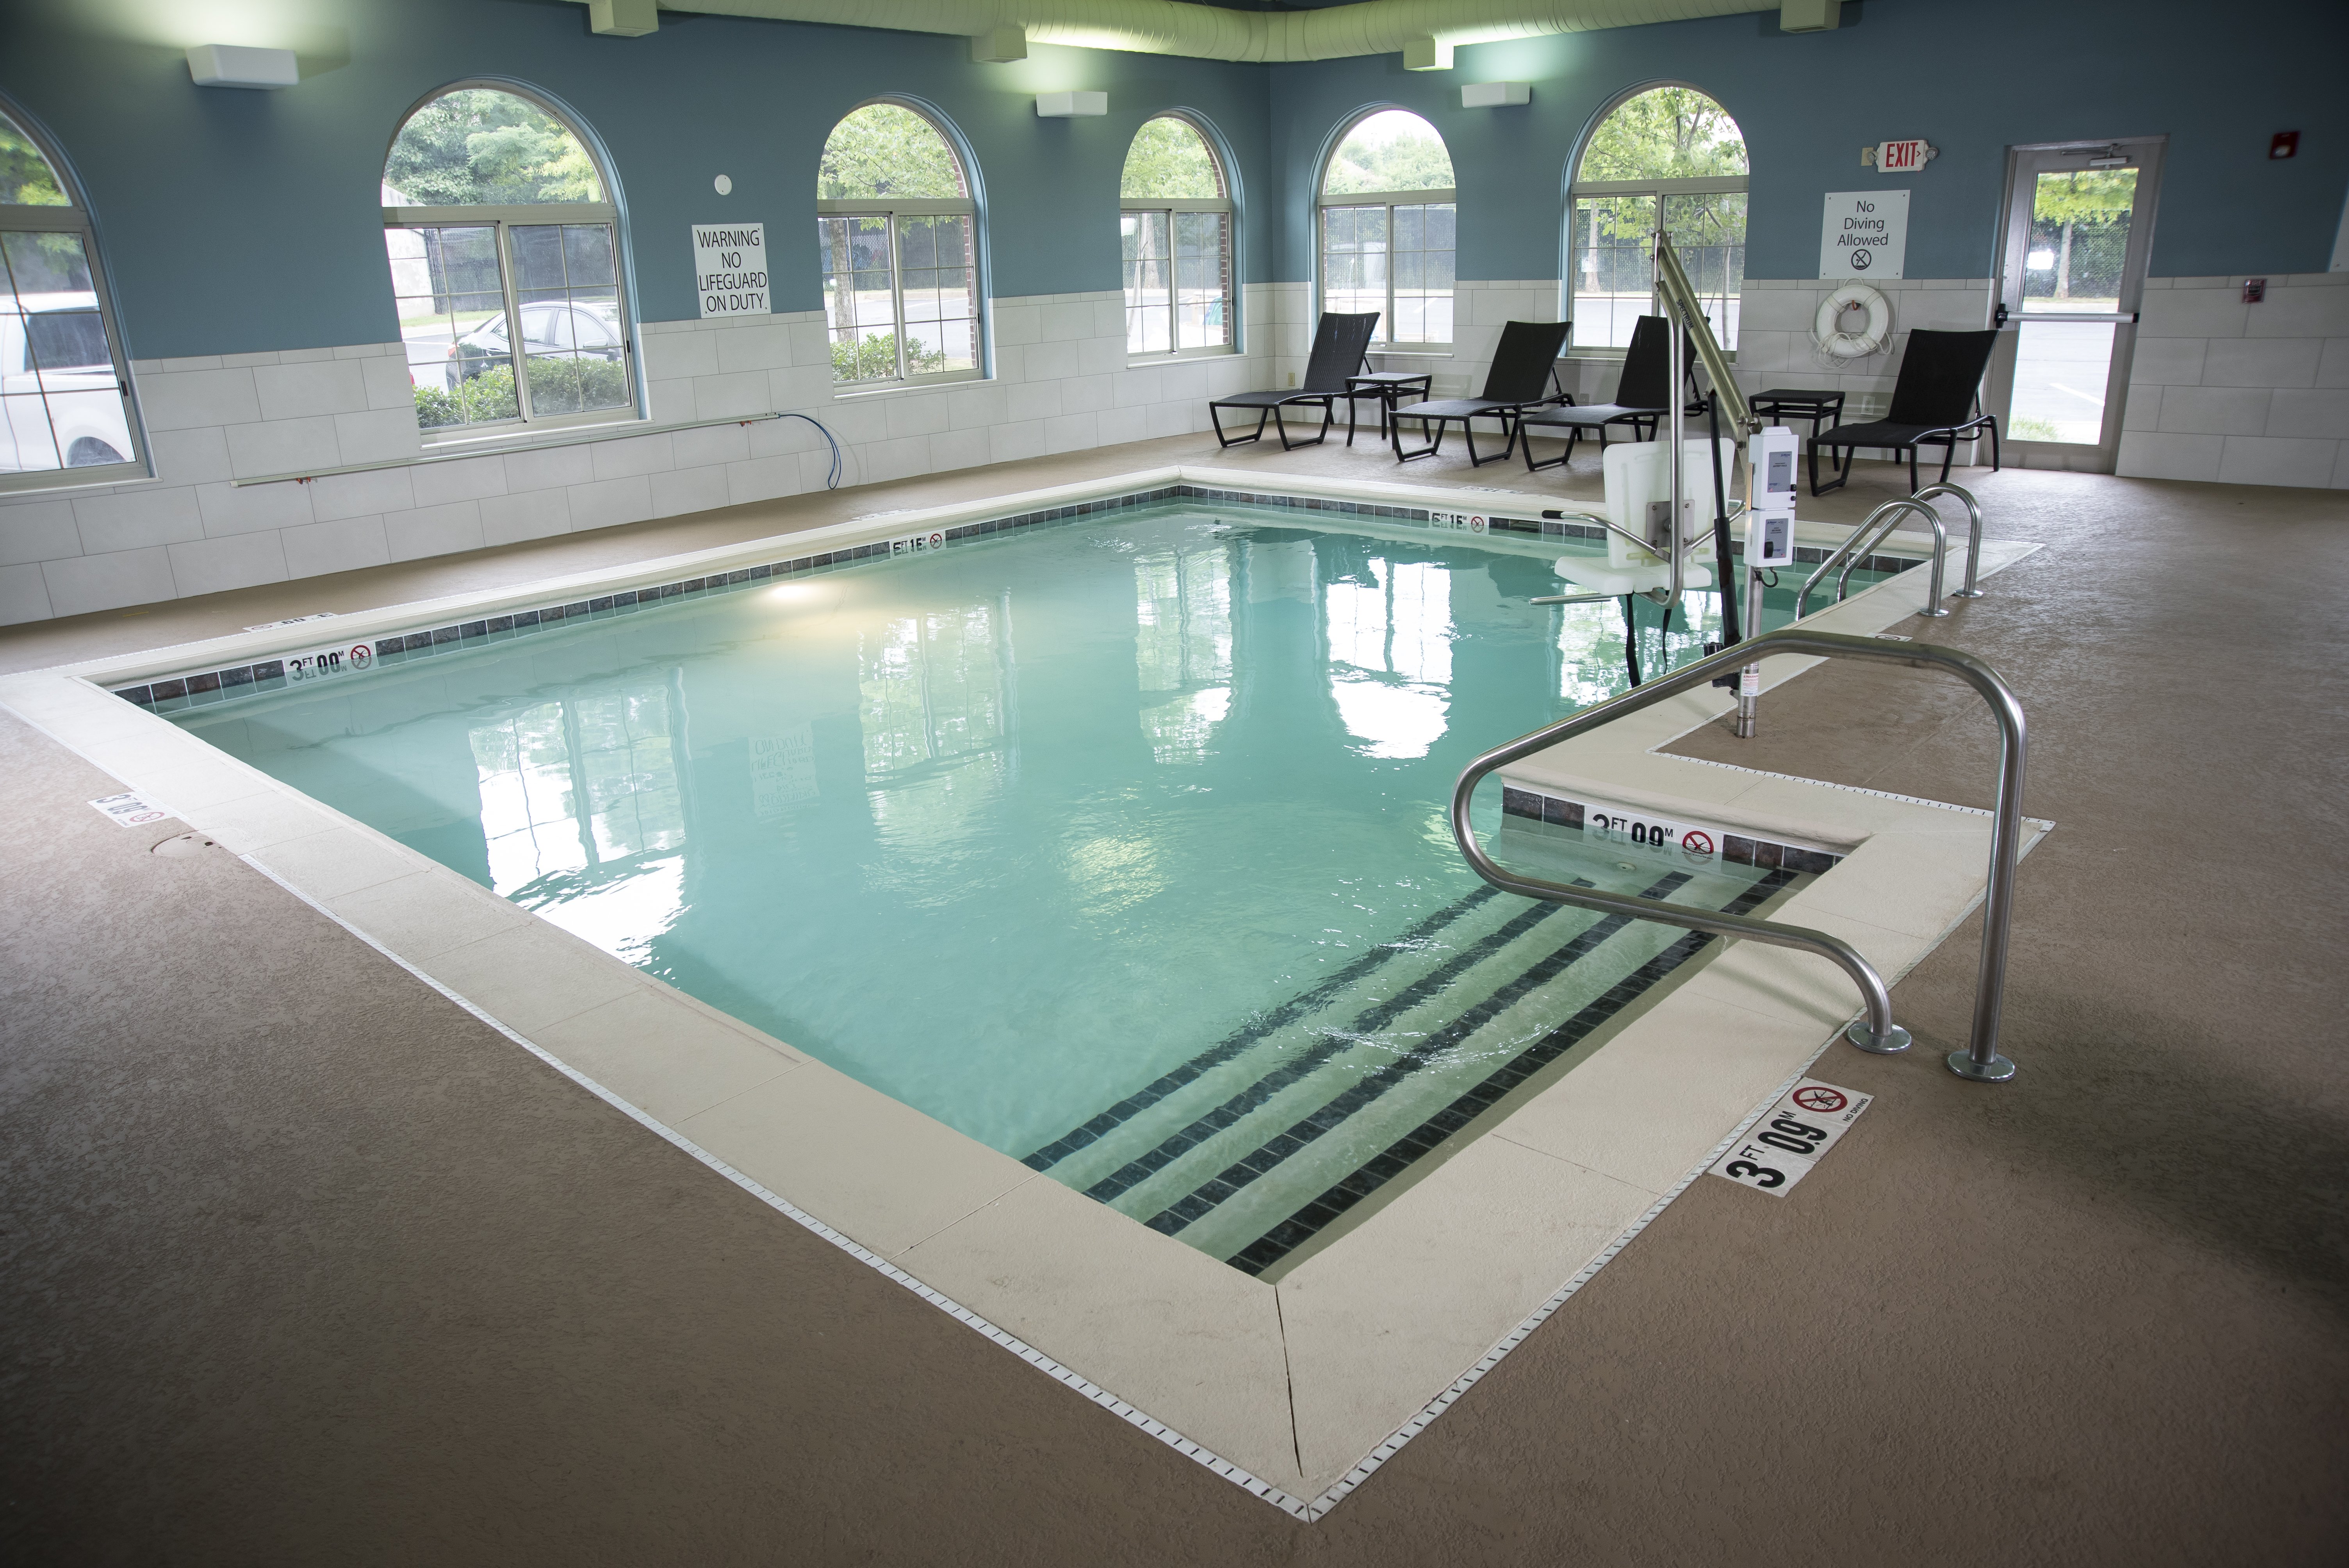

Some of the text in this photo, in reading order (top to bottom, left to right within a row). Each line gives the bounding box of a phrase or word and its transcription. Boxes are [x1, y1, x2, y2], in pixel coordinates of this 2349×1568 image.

[1886, 142, 1918, 168] EXIT
[1856, 201, 1875, 213] No
[1844, 217, 1885, 232] Diving
[697, 230, 760, 248] WARNING
[1837, 233, 1889, 246] Allowed
[721, 251, 741, 269] NO
[699, 271, 767, 291] LIFEGUARD
[706, 292, 764, 312] ON DUTY
[1676, 299, 1694, 330] SPECTRUM
[1842, 1098, 1869, 1122] NO DIVING
